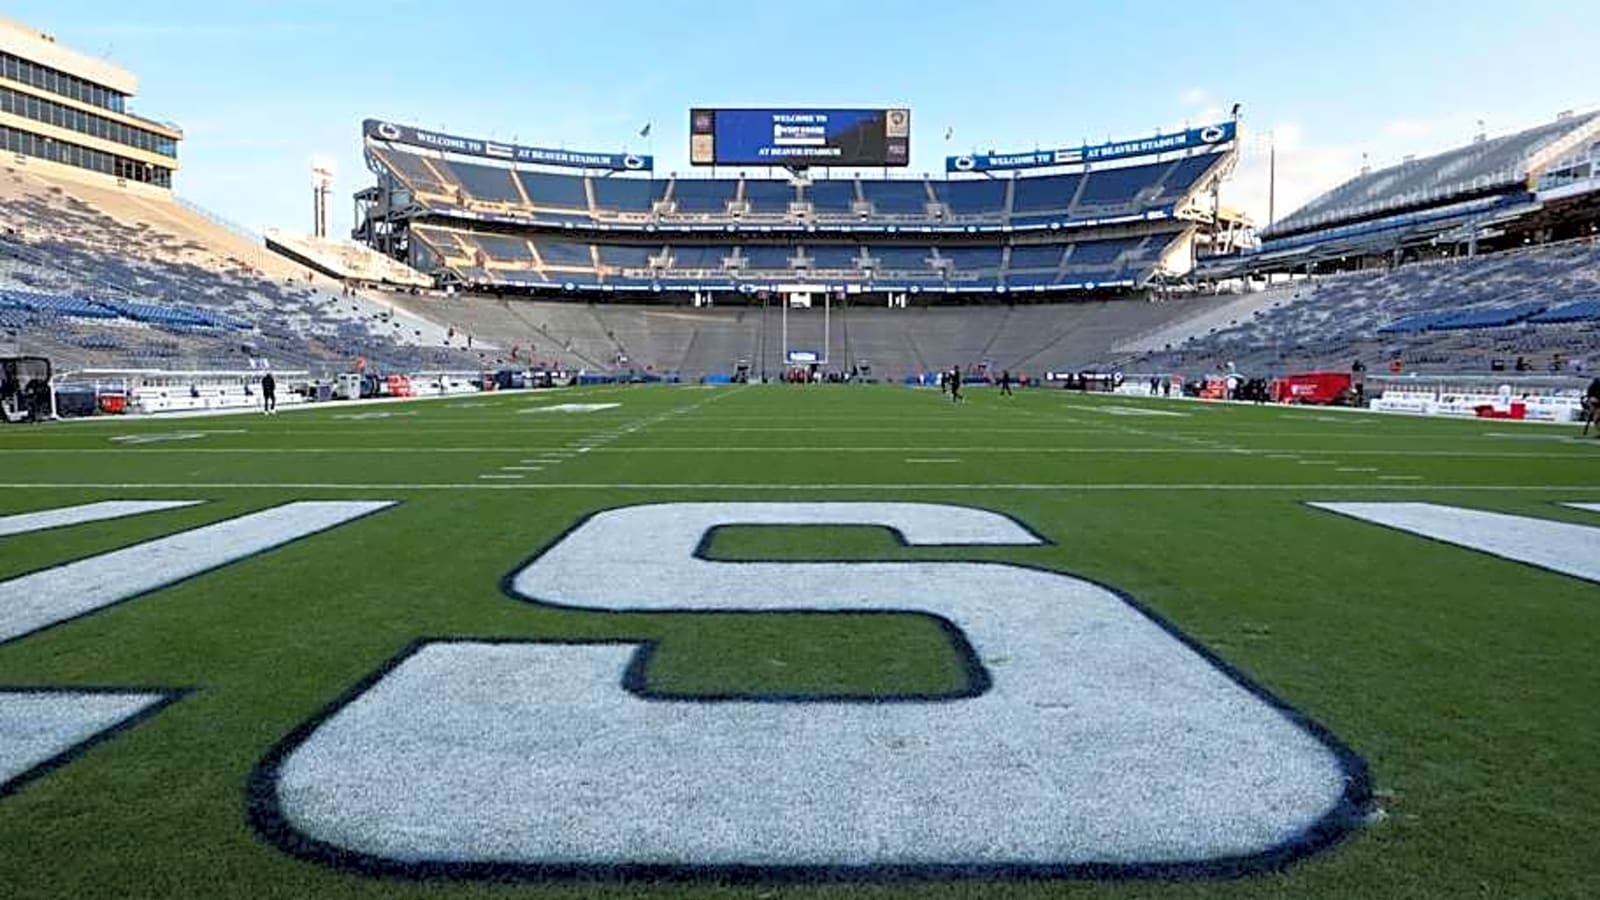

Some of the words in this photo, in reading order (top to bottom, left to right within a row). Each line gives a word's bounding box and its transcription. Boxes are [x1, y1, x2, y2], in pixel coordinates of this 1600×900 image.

[772, 114, 814, 122] WELCOME
[815, 114, 828, 122] TO
[417, 133, 466, 149] WELCOME
[468, 142, 482, 152] TO
[1086, 149, 1099, 158] AT
[1100, 143, 1140, 156] BEAVER
[1141, 135, 1187, 150] STADIUM
[517, 149, 530, 159] AT
[532, 150, 568, 162] BEAVER
[569, 154, 611, 165] STADIUM
[803, 148, 842, 156] STADIUM
[988, 155, 1035, 167] WELCOME
[1036, 154, 1051, 164] TO
